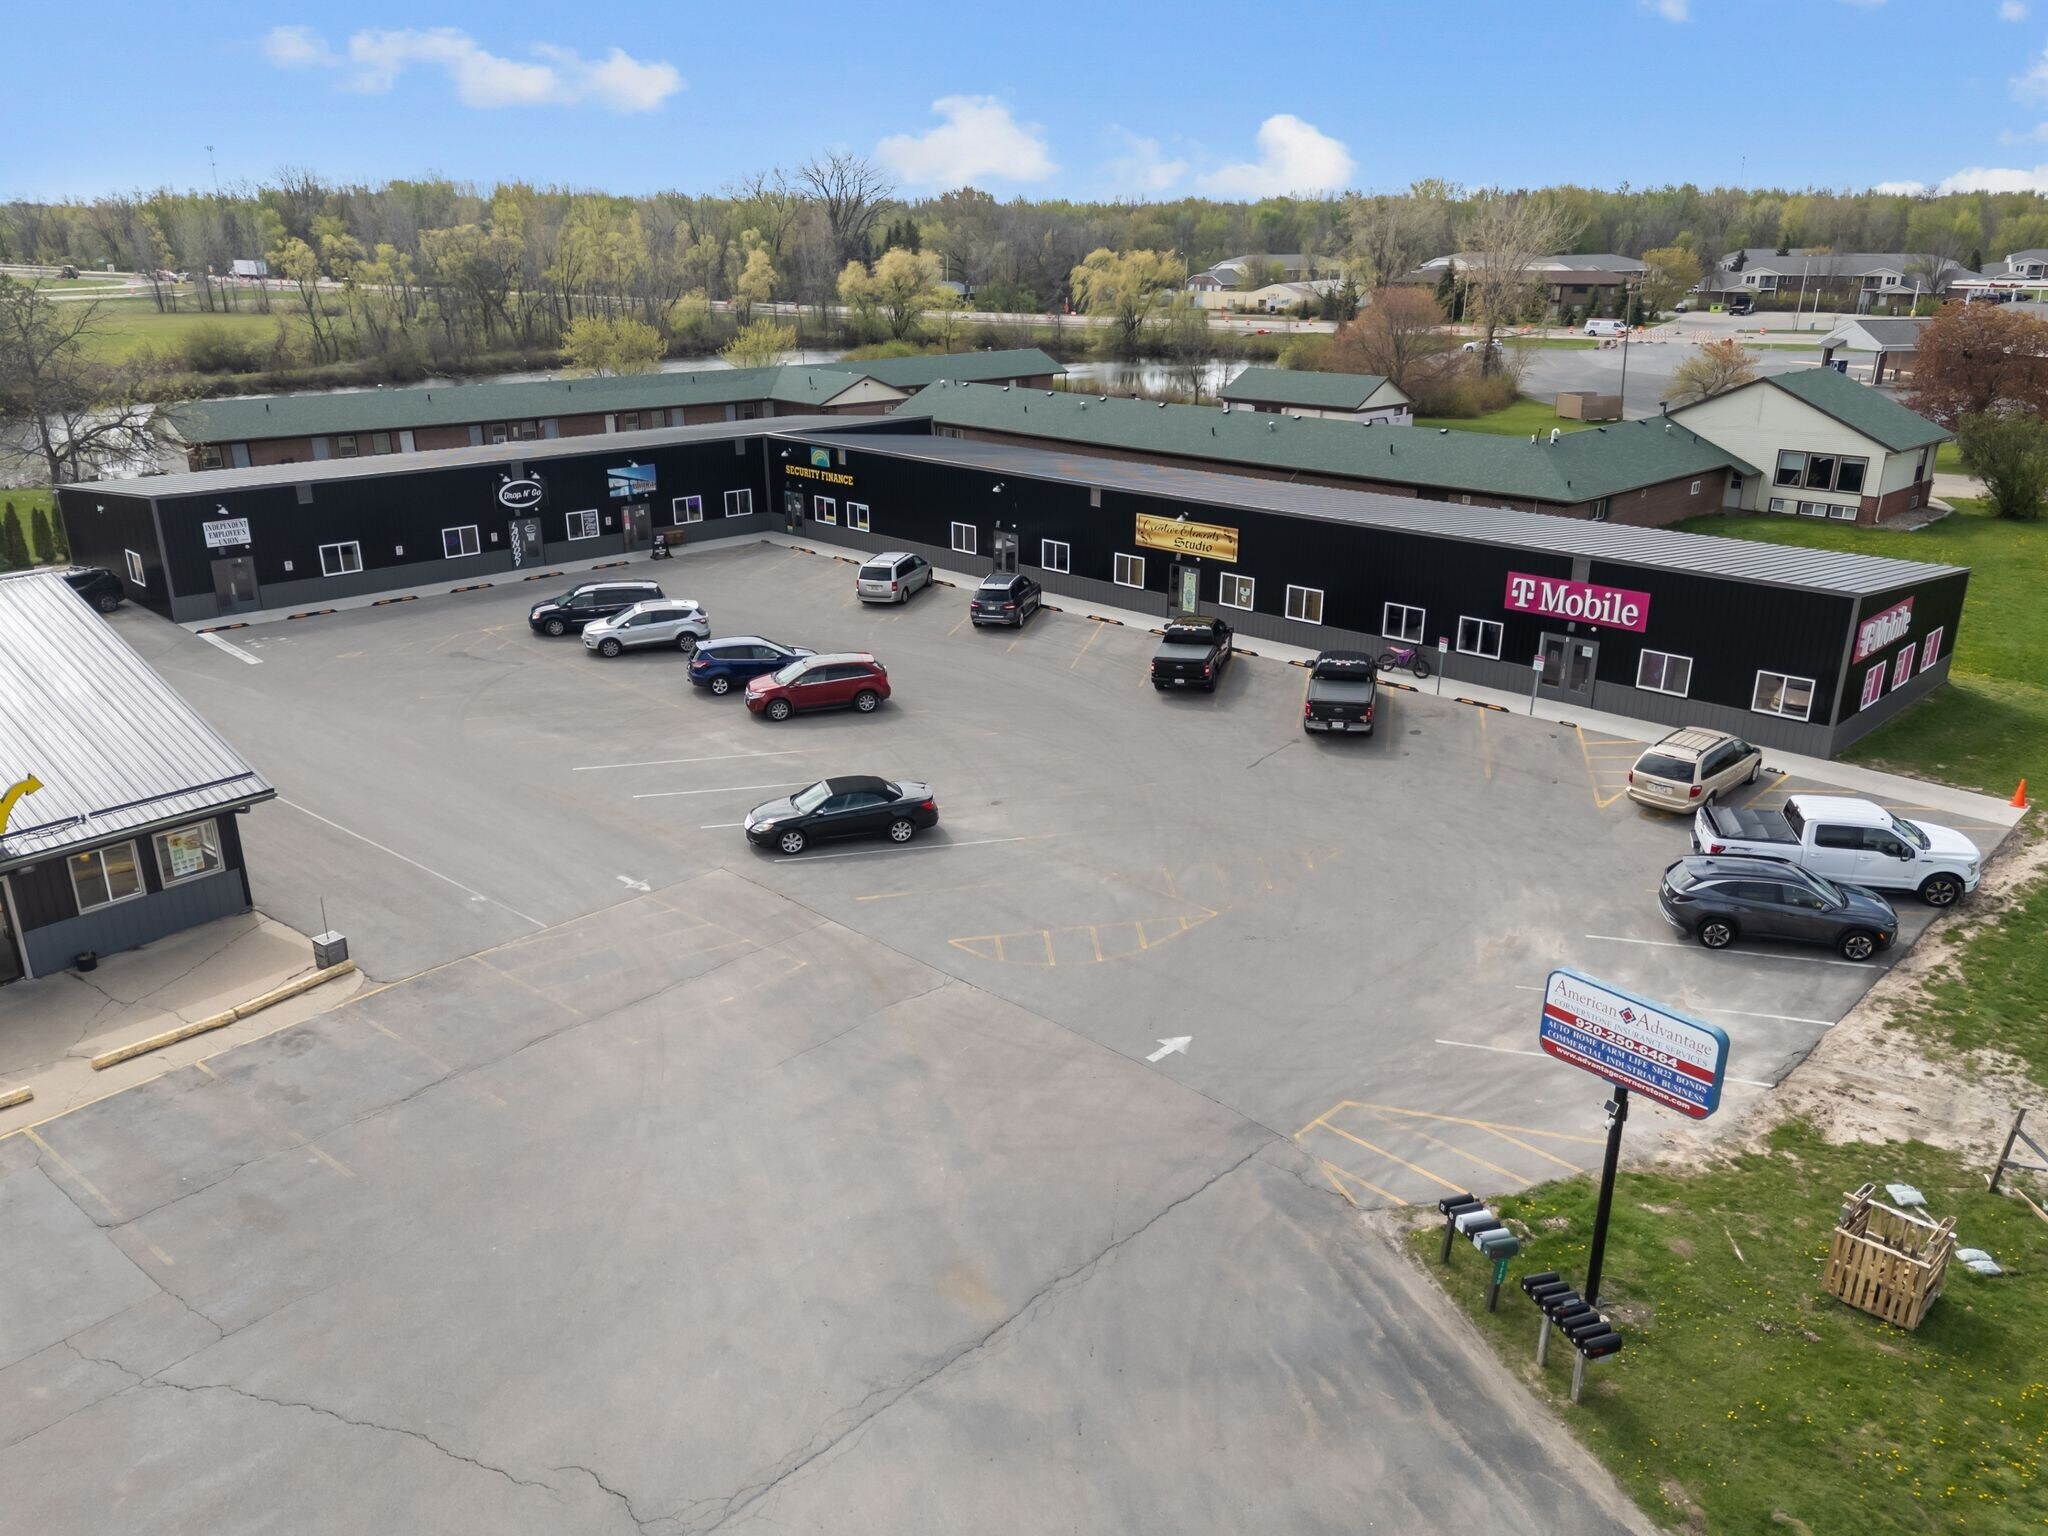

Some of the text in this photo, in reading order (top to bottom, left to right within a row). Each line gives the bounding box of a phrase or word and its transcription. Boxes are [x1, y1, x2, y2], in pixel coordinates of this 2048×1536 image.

[504, 491, 522, 500] Drop
[531, 488, 541, 496] Go
[785, 464, 854, 485] SECURITY FINANCE
[205, 520, 247, 531] INDEPENDENT
[218, 537, 239, 545] UNION
[1143, 520, 1220, 541] Creative Elements
[1174, 537, 1213, 552] Studio
[1538, 582, 1639, 626] Mobile
[1553, 998, 1708, 1067] CORNERSTONE INSURANCE SERVICES
[1554, 979, 1713, 1056] American Advantage
[1548, 1020, 1708, 1094] AUTO HOME FARM LIFE SR22 BONDS
[1575, 1017, 1679, 1069] 920-250-6464
[1547, 1029, 1705, 1104] COMMERCIAL INDUSTRIAL BUSINESS
[1556, 1046, 1690, 1110] www.advantagecornerstone.com
